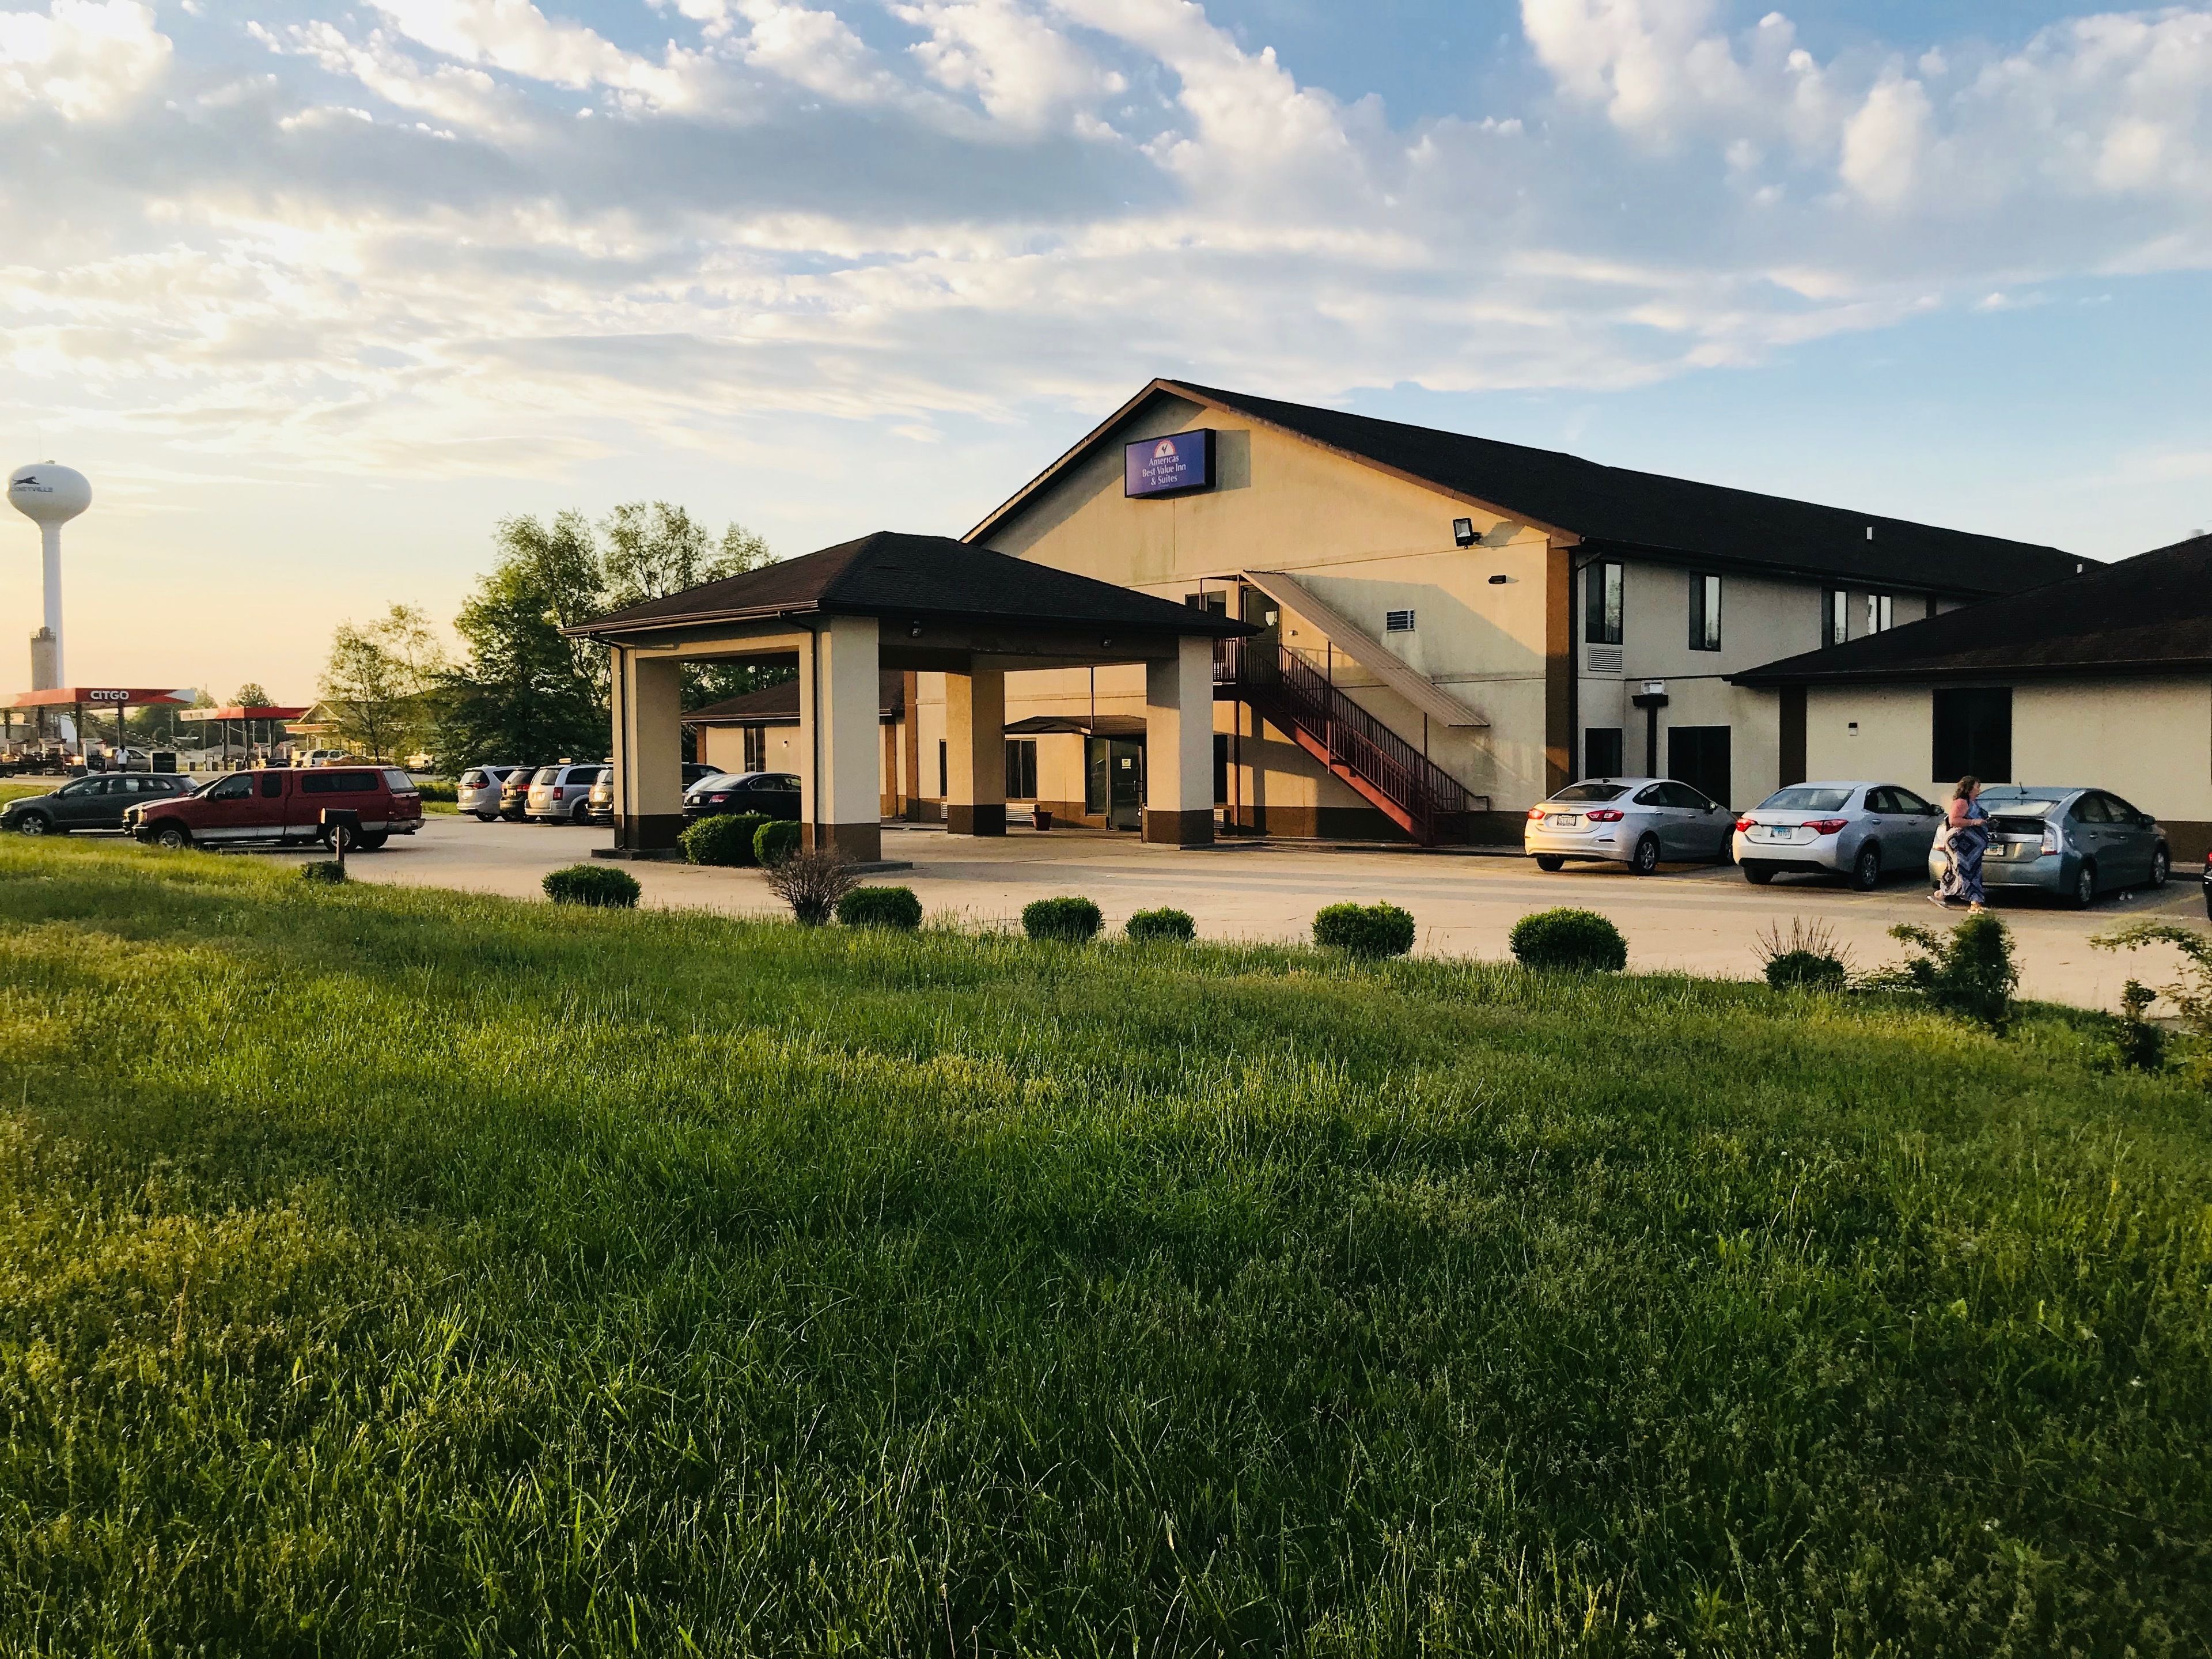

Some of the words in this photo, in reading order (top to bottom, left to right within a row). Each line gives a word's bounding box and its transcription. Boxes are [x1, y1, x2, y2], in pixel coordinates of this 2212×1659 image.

[1149, 455, 1179, 466] Americas
[1142, 468, 1156, 477] Best
[1157, 464, 1174, 474] Value
[1175, 463, 1186, 471] Inn
[1150, 476, 1156, 485] &
[1158, 474, 1177, 484] Suites
[90, 690, 129, 700] CITGO
